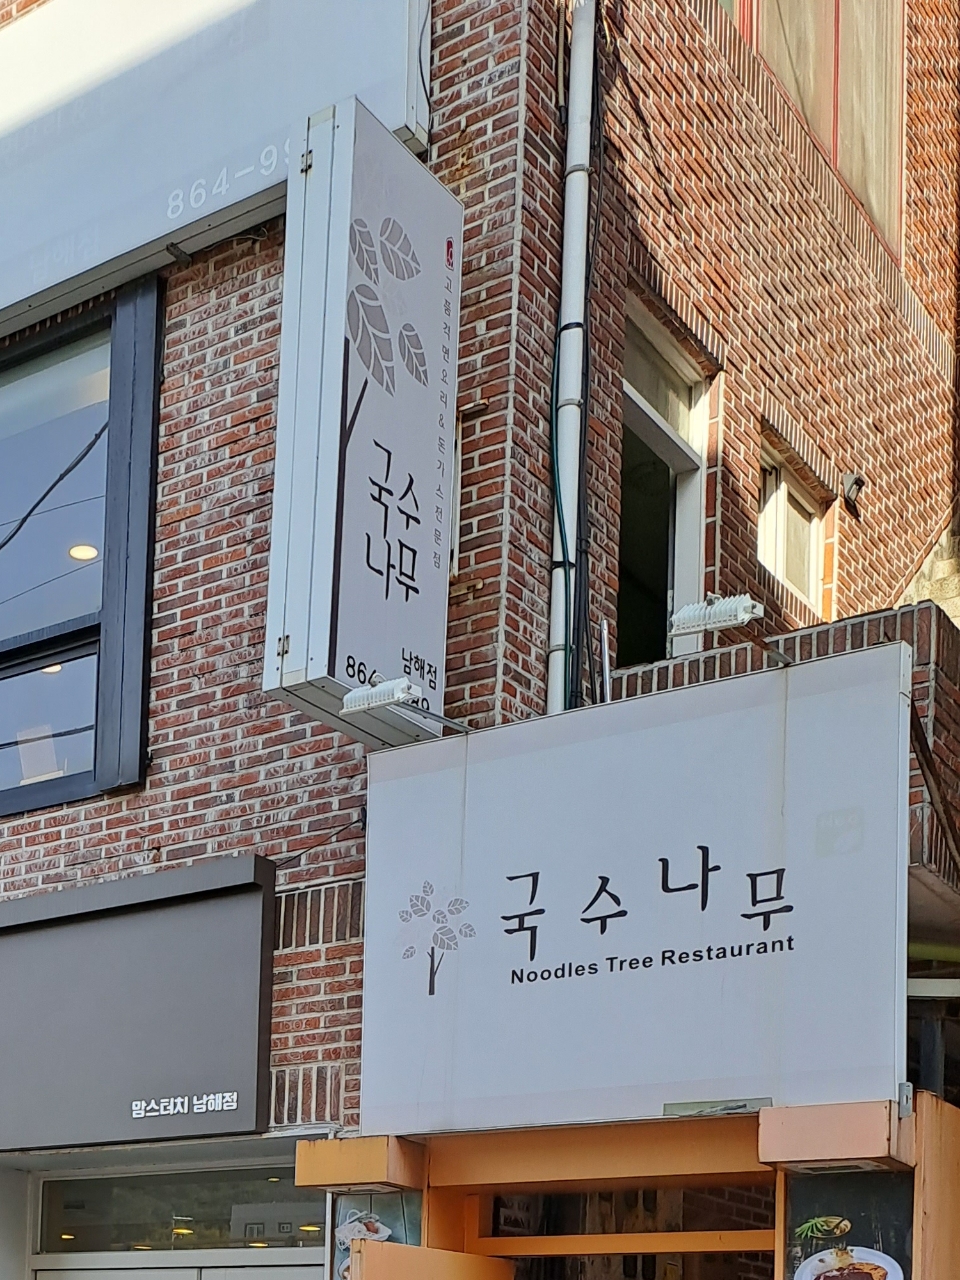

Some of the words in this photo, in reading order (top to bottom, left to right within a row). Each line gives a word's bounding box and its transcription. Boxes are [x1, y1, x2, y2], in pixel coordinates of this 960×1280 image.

[368, 439, 422, 538] 국수
[365, 532, 421, 603] 나무
[401, 647, 437, 691] 남해점
[500, 844, 794, 962] 국수나무
[510, 960, 599, 985] Noodles
[605, 951, 654, 973] Tree
[660, 935, 795, 967] Restaurant
[131, 1096, 189, 1118] 맘스터치
[192, 1092, 238, 1113] 남해점
